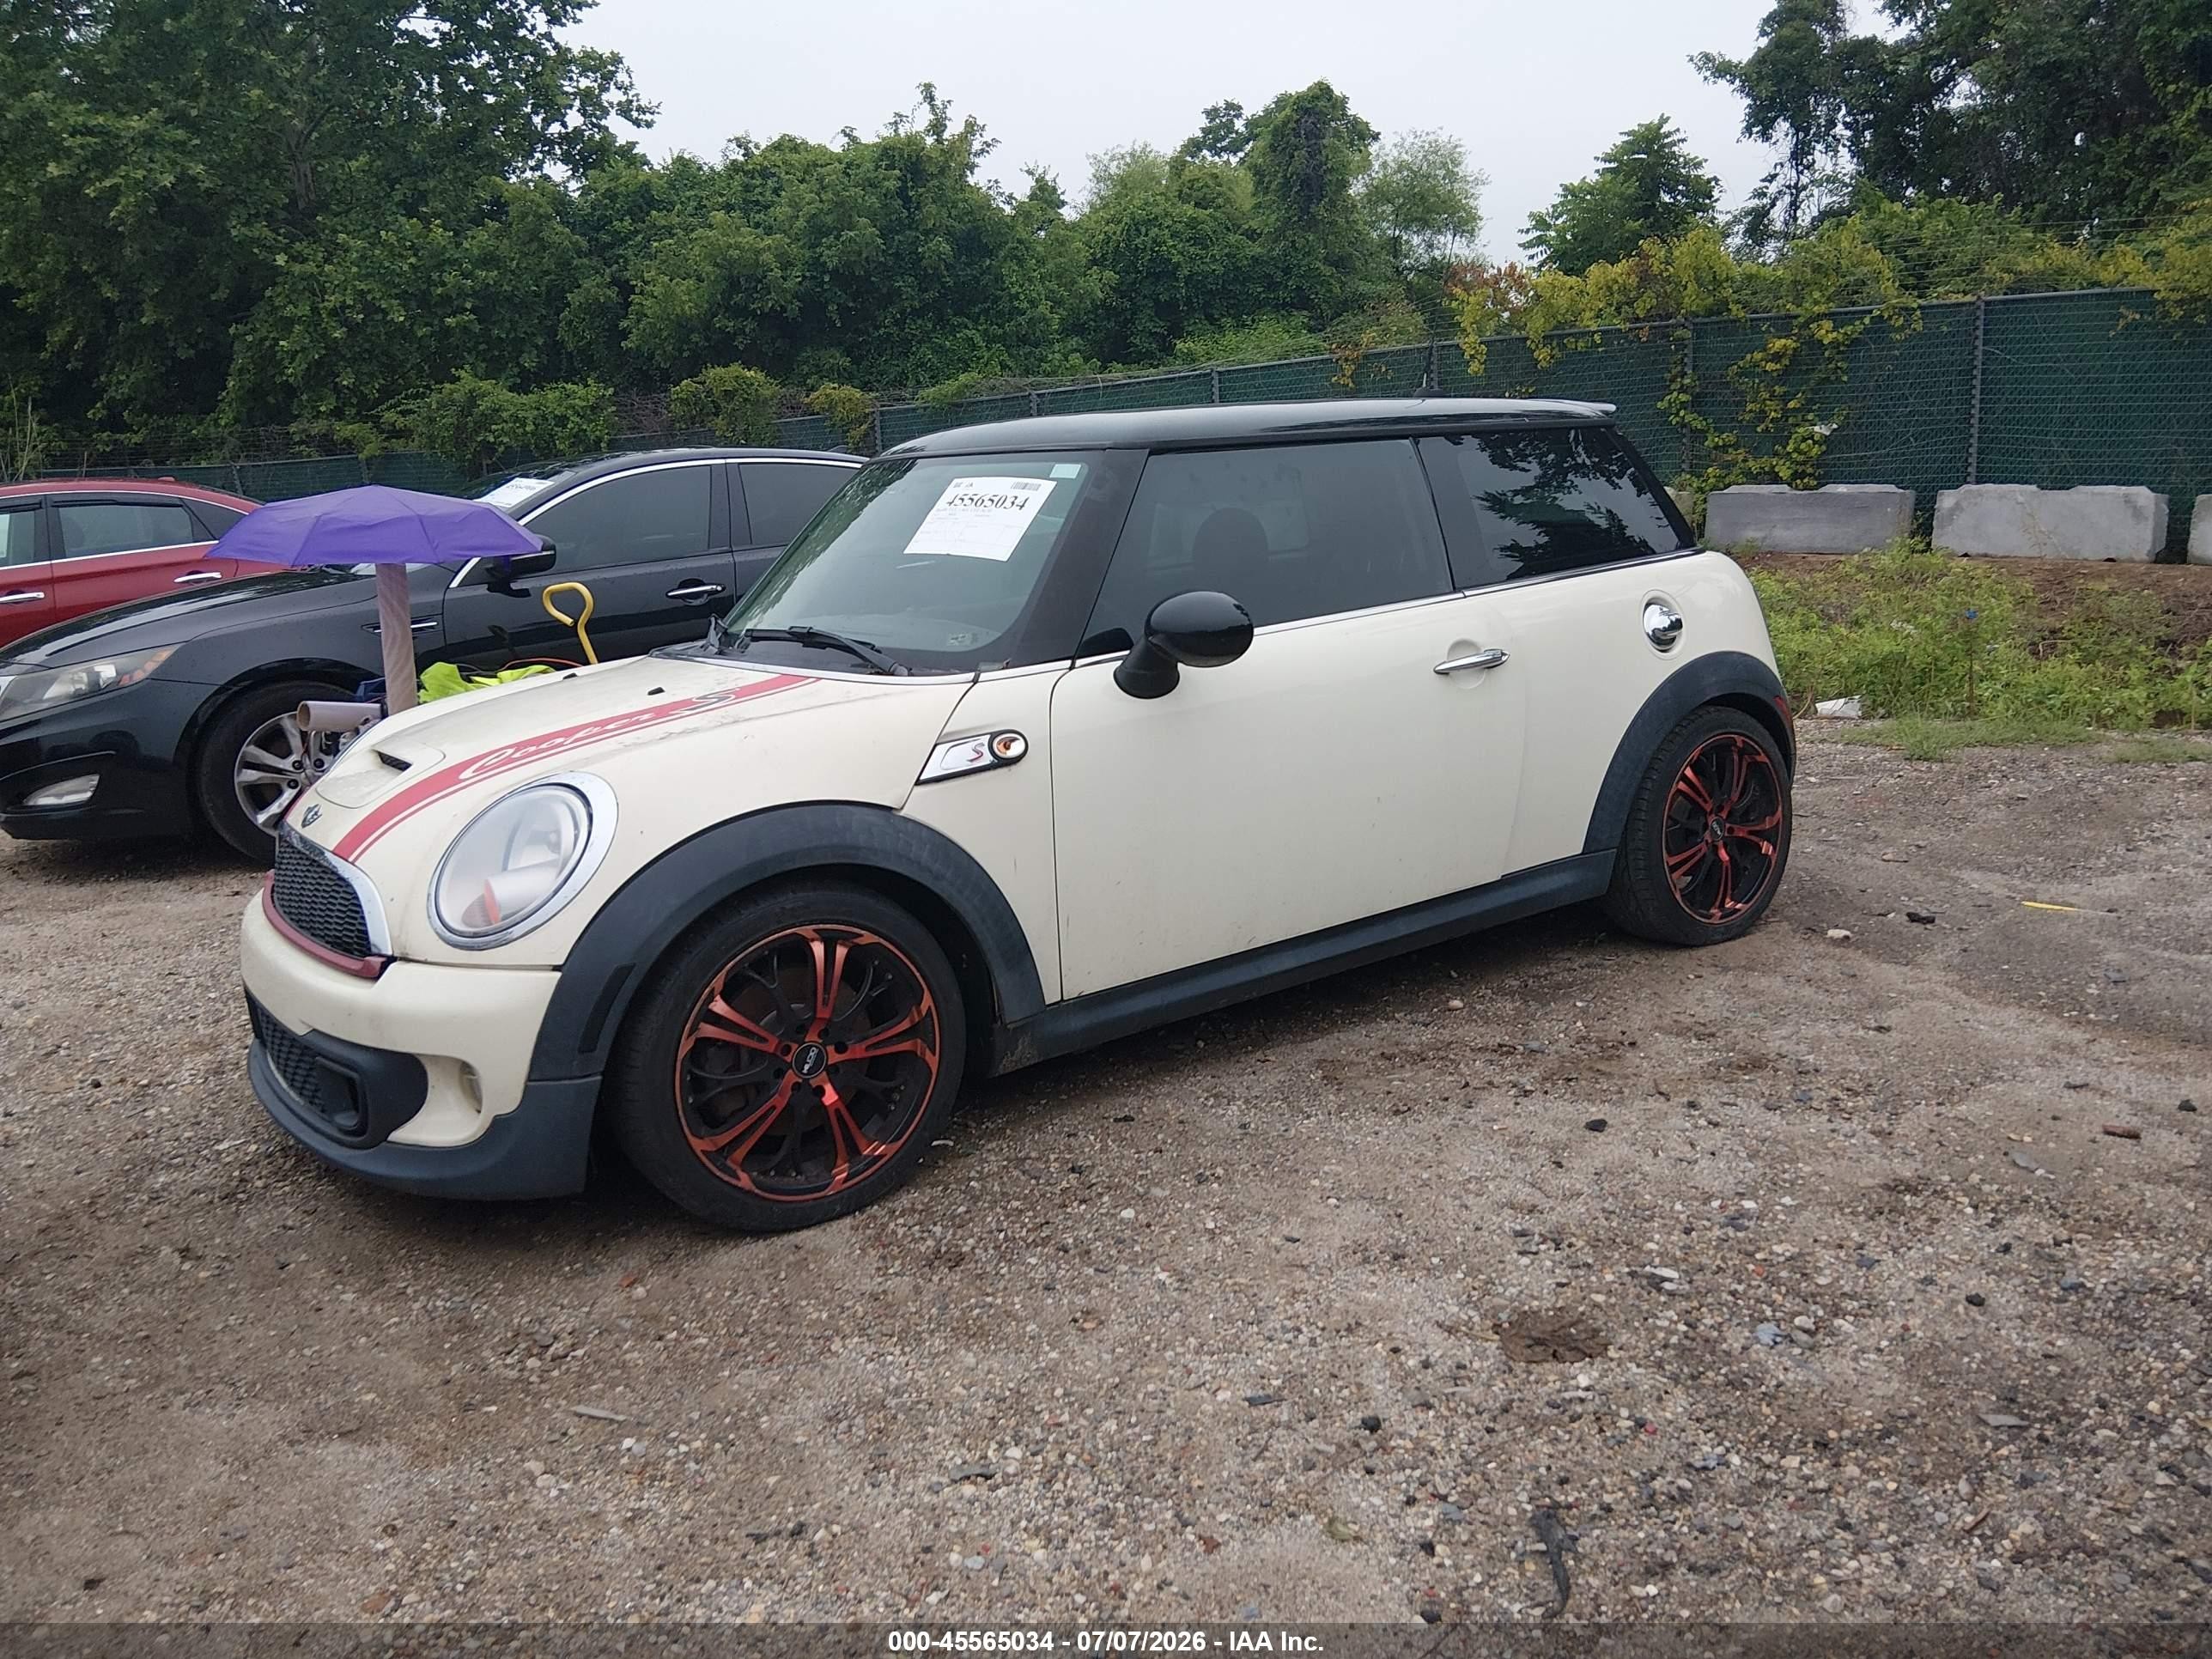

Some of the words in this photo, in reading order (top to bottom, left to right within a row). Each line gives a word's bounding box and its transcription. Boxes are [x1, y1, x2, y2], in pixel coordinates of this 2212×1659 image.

[946, 493, 1030, 510] 45565034
[459, 712, 655, 780] Cooper
[668, 687, 740, 716] S
[966, 742, 985, 763] S
